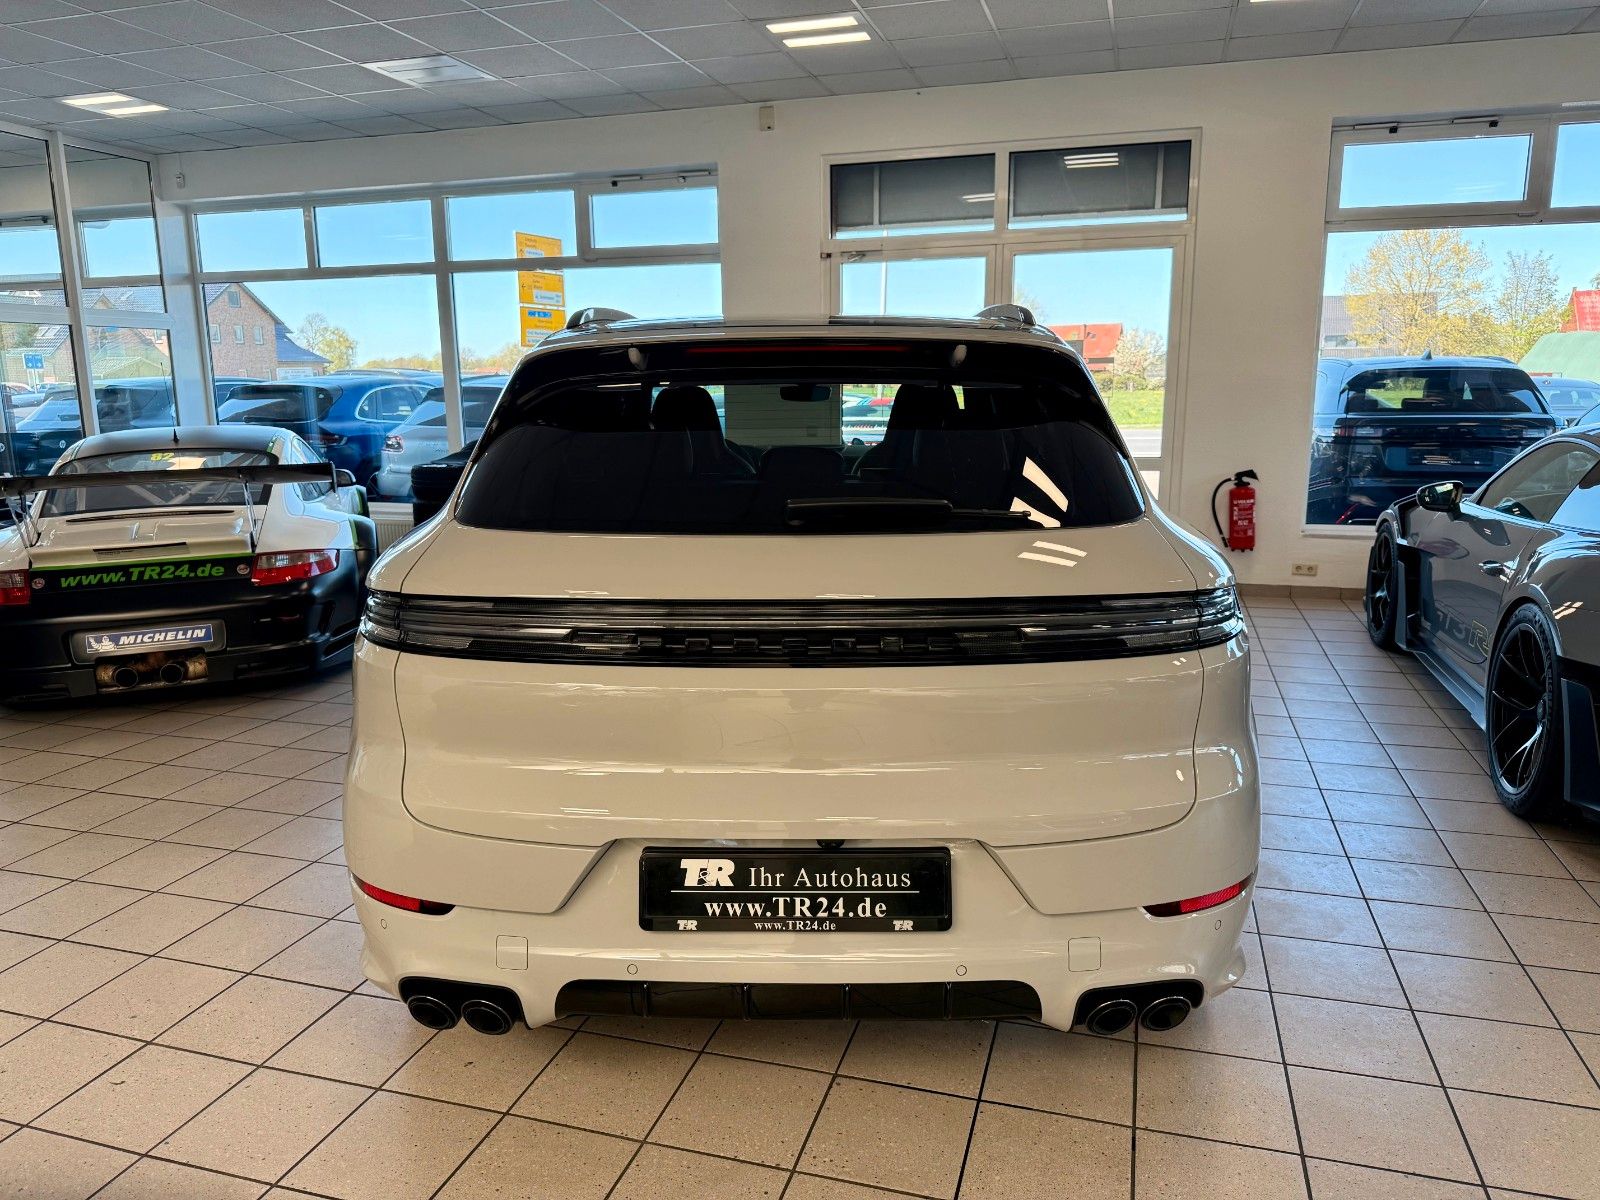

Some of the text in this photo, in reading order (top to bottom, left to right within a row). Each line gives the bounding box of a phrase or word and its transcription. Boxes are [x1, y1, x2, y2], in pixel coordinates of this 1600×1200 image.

[60, 563, 225, 588] www.TR24.de
[118, 628, 207, 645] MICHELIN
[748, 867, 785, 888] Ihr
[794, 866, 911, 888] Autohaus
[704, 897, 887, 919] www.TR24.de
[754, 920, 836, 931] www.TR24.de
